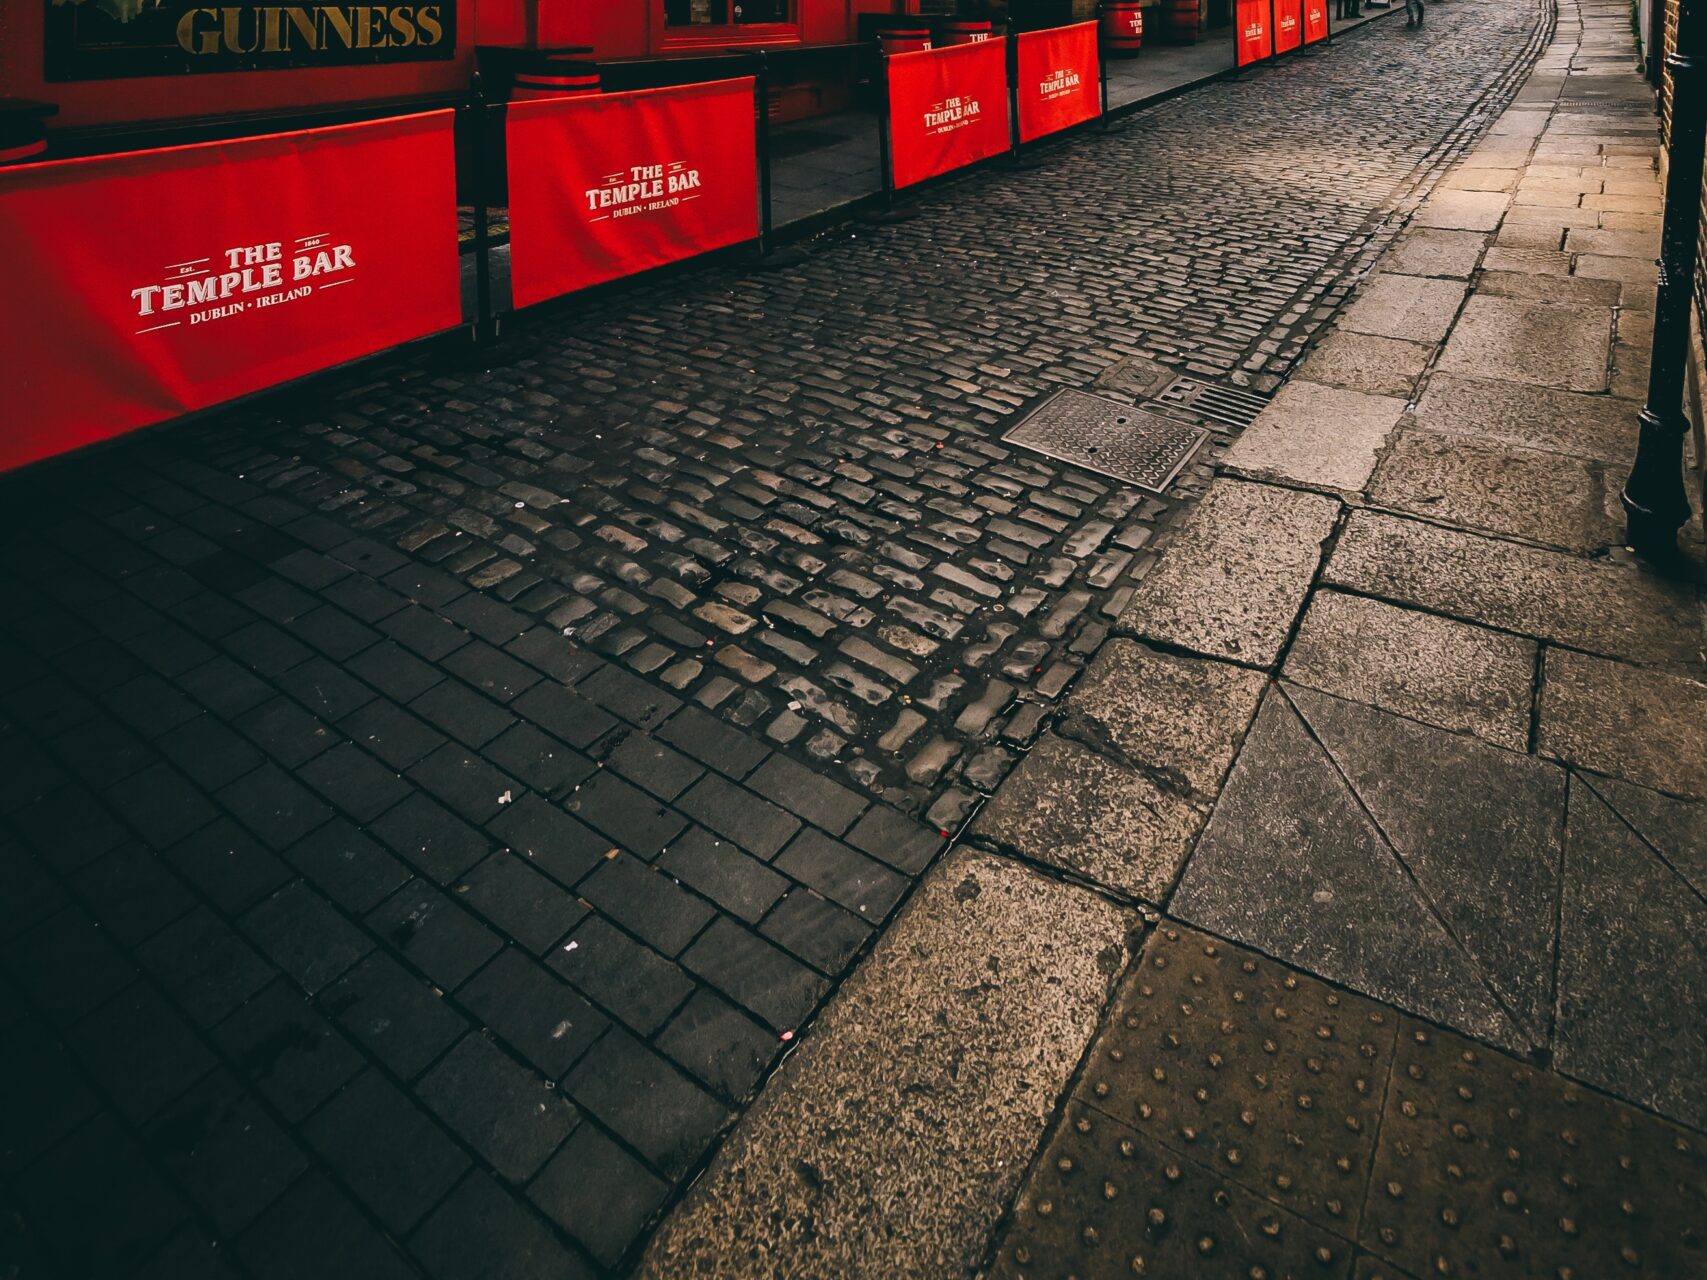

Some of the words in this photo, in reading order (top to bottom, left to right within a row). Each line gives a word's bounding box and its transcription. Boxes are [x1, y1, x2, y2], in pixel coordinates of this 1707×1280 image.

[176, 6, 443, 55] GUINNESS
[924, 107, 962, 128] TEMPLE
[631, 164, 663, 182] THE
[585, 179, 664, 211] TEMPLE
[667, 169, 701, 194] BAR
[613, 205, 642, 219] DUBLIN
[648, 197, 679, 211] IRELAND
[225, 242, 283, 269] THE
[131, 263, 283, 317] TEMPLE
[292, 243, 356, 281] BAR
[190, 301, 245, 325] DUBLIN
[256, 285, 312, 309] IRELAND
